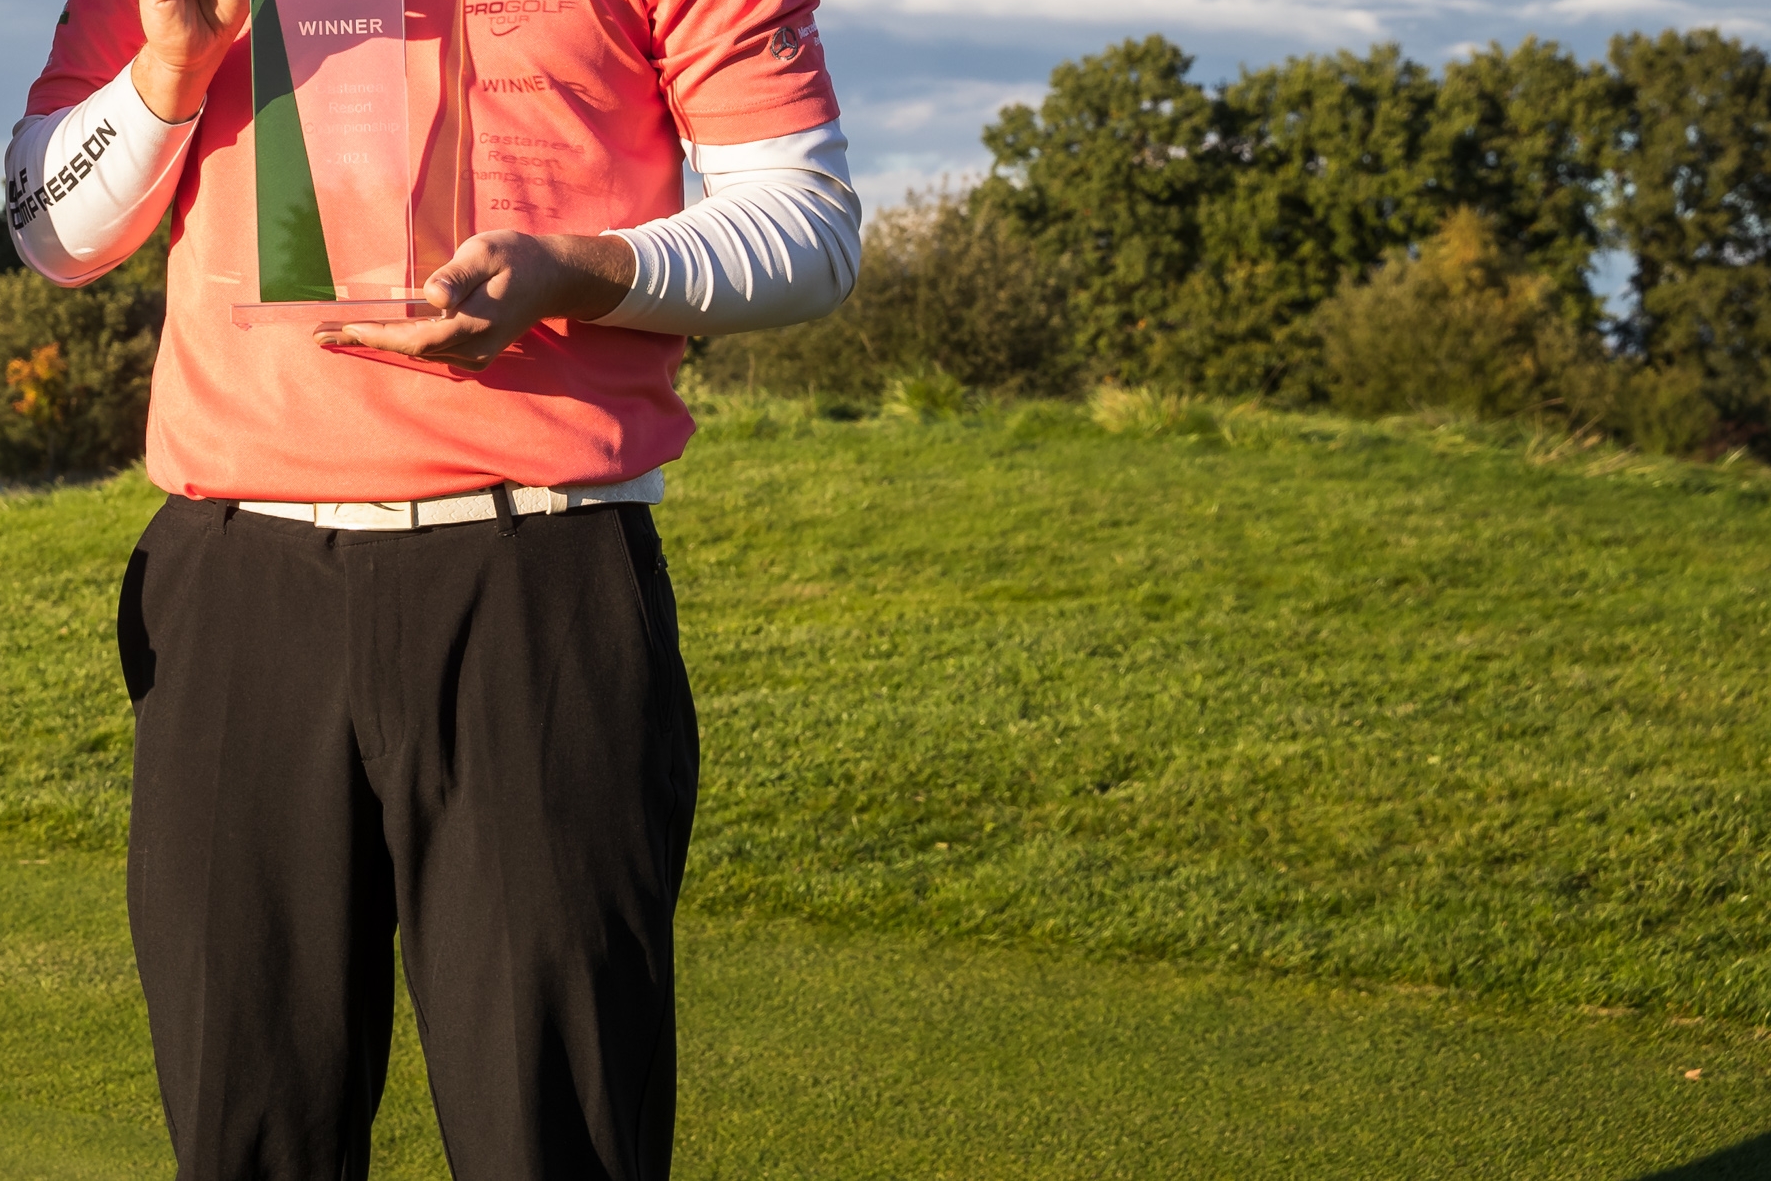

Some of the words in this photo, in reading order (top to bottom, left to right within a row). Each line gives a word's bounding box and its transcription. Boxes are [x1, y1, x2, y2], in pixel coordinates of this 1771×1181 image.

[465, 0, 576, 16] PROGOLF
[298, 18, 384, 36] WINNER
[488, 15, 530, 25] TOUR
[329, 102, 373, 114] Resort
[304, 120, 400, 135] Campionship
